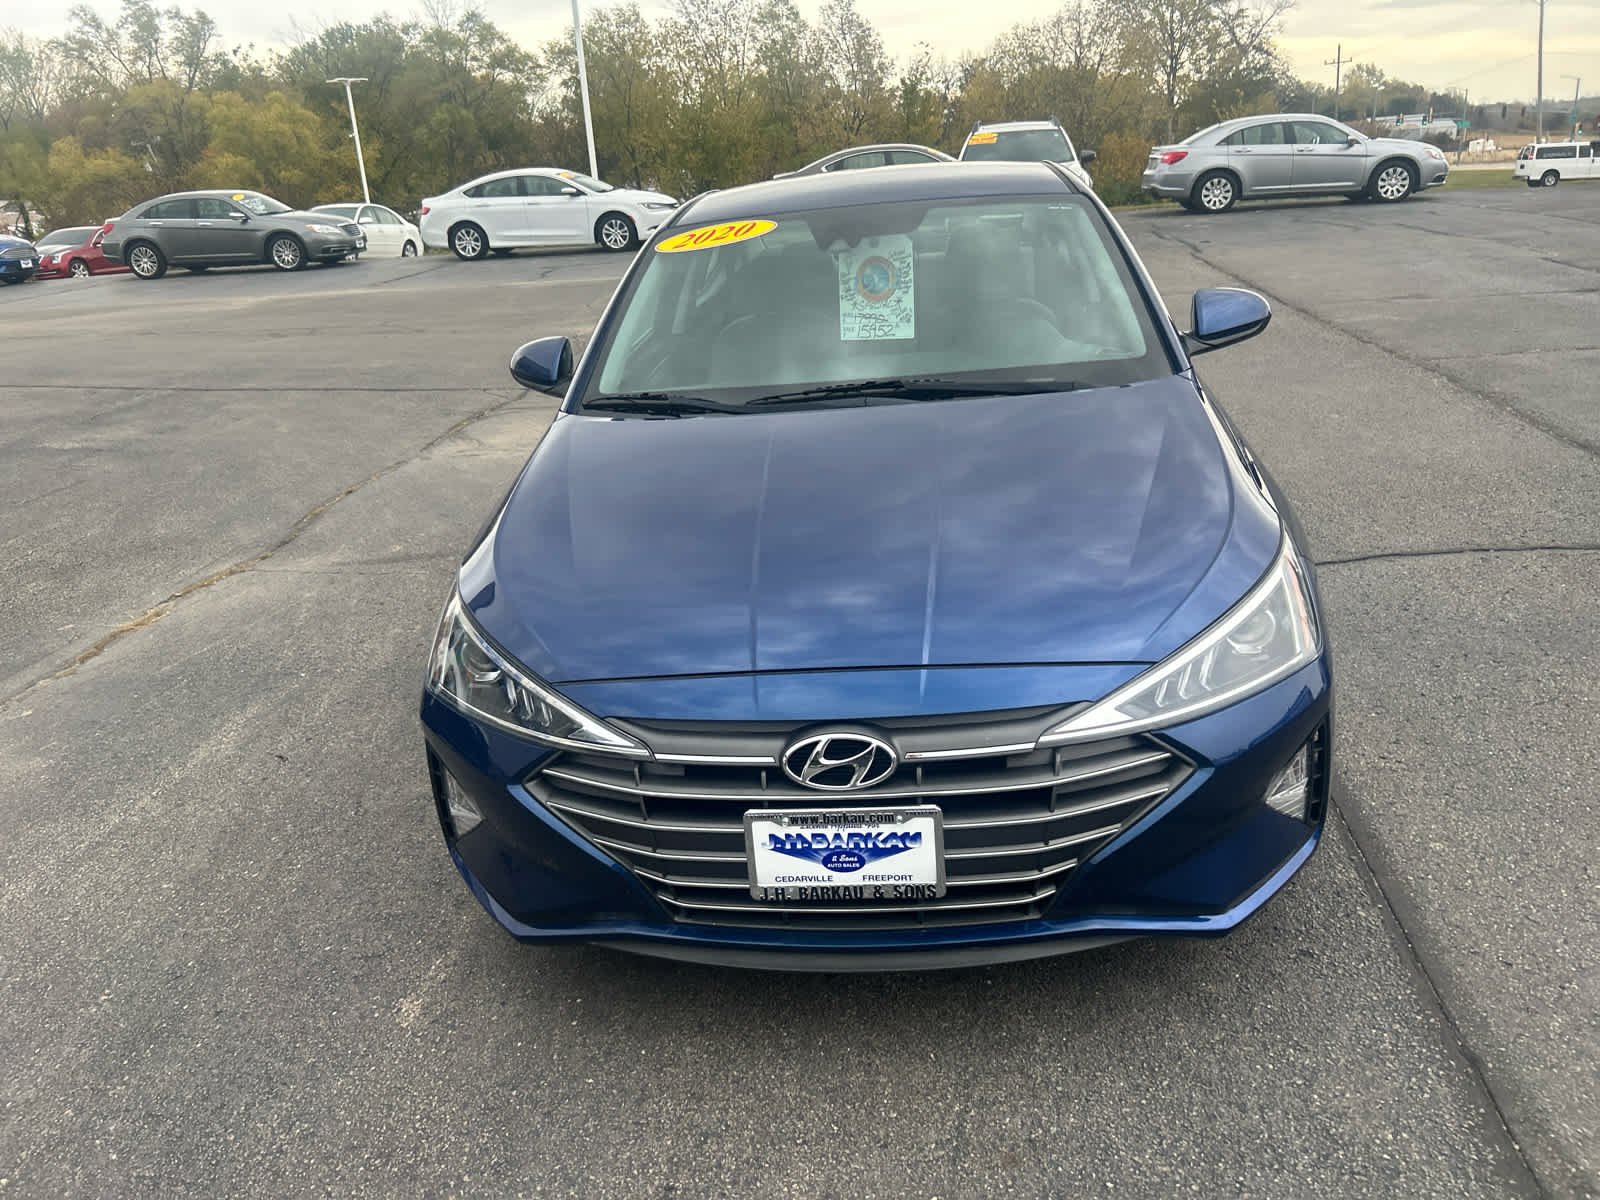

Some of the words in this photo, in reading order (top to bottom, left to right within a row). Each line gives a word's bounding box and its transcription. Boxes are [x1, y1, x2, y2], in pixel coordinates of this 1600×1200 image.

[672, 222, 757, 249] 2020
[790, 811, 895, 825] www.barkau.com
[839, 854, 858, 862] Sons
[775, 875, 833, 883] CEDARVILLE
[862, 874, 913, 882] FREEPORT
[759, 887, 791, 901] J.H.
[799, 885, 864, 900] BARKAU
[873, 885, 884, 898] &
[894, 884, 936, 899] SONS
